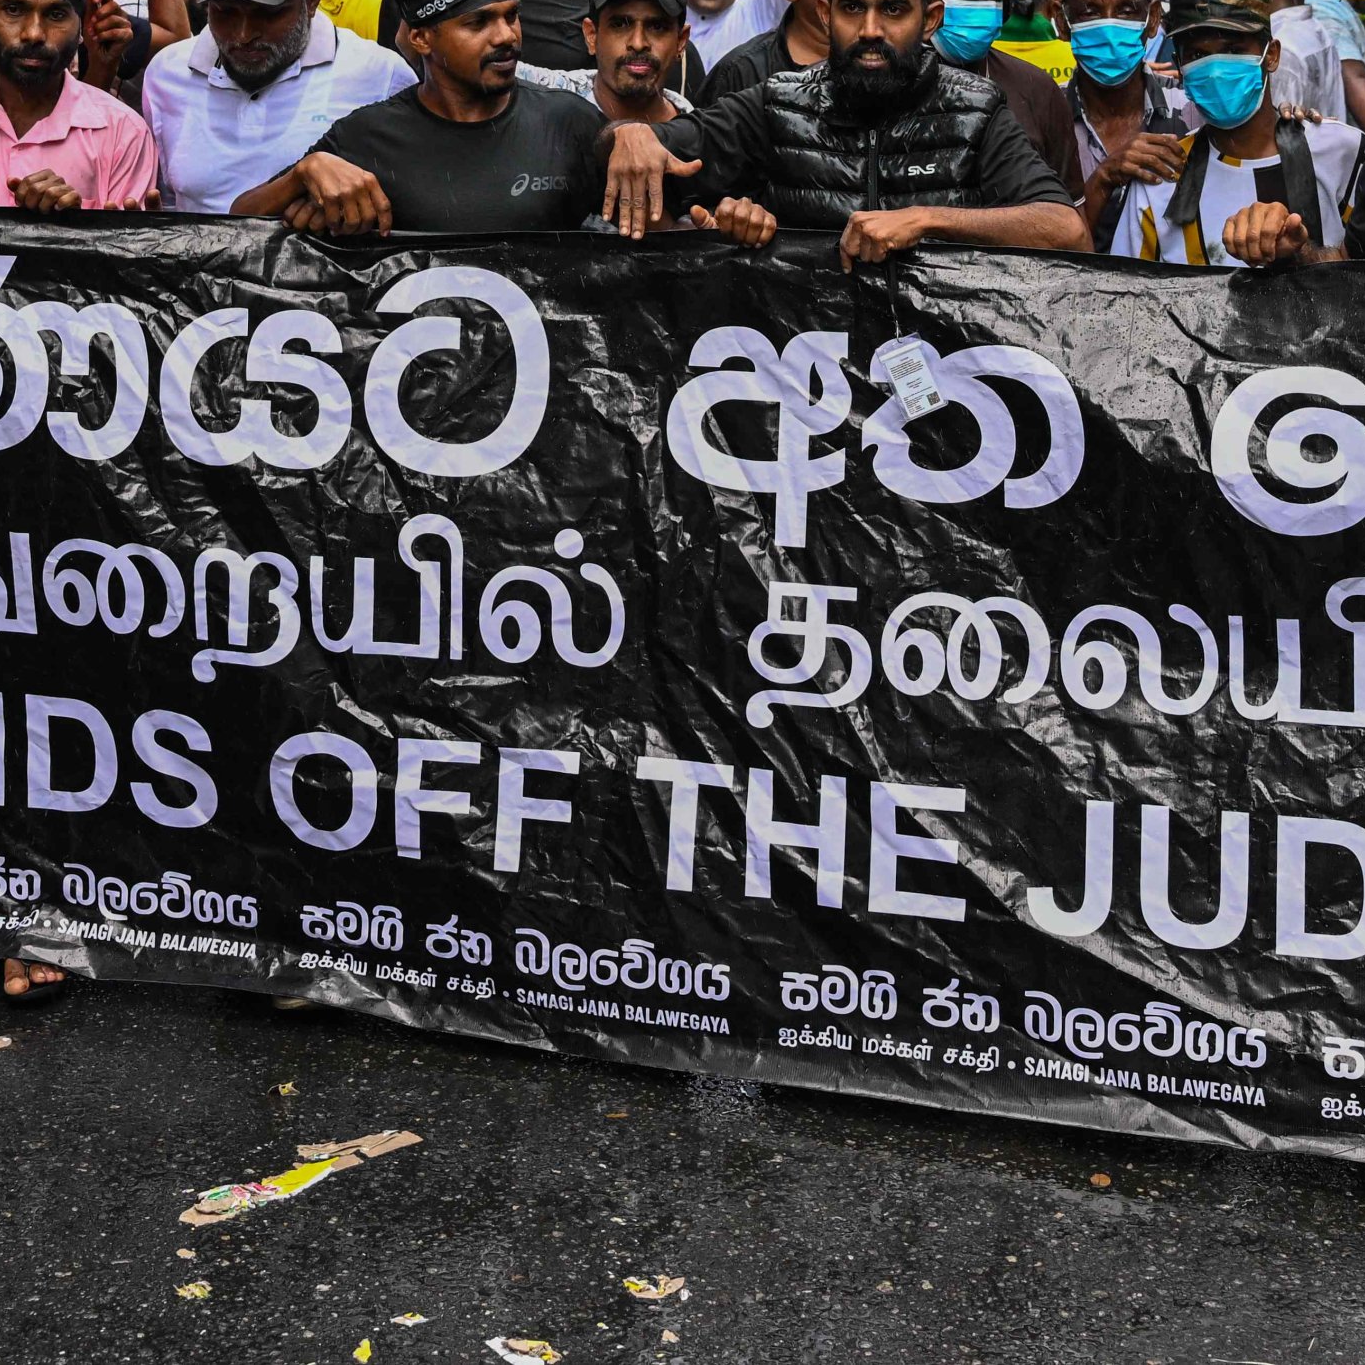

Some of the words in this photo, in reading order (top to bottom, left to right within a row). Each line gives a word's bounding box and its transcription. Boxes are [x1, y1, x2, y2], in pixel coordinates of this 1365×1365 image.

[666, 325, 1086, 548] අත
[268, 730, 580, 877] OFF
[636, 755, 966, 923] THE
[57, 917, 113, 942] SAMAGI
[115, 926, 157, 949] JANA
[159, 933, 257, 960] BALAWEGAYA
[299, 901, 404, 951] සමගි
[425, 914, 493, 967] ජන
[375, 962, 438, 988] மக்கள்
[446, 973, 496, 1001] சக்தி
[516, 988, 574, 1013] SAMAGI
[577, 998, 620, 1020] JANA
[625, 1005, 730, 1035] BALAWEGAYA
[780, 964, 898, 1021] සමගි
[922, 978, 1000, 1033] ජන
[862, 1035, 933, 1062] மக்கள்
[943, 1046, 1000, 1074] சக்தி
[1024, 1055, 1089, 1083] SAMAGI
[1093, 1066, 1142, 1091] JANA
[1147, 1074, 1266, 1107] BALAWEGAYA
